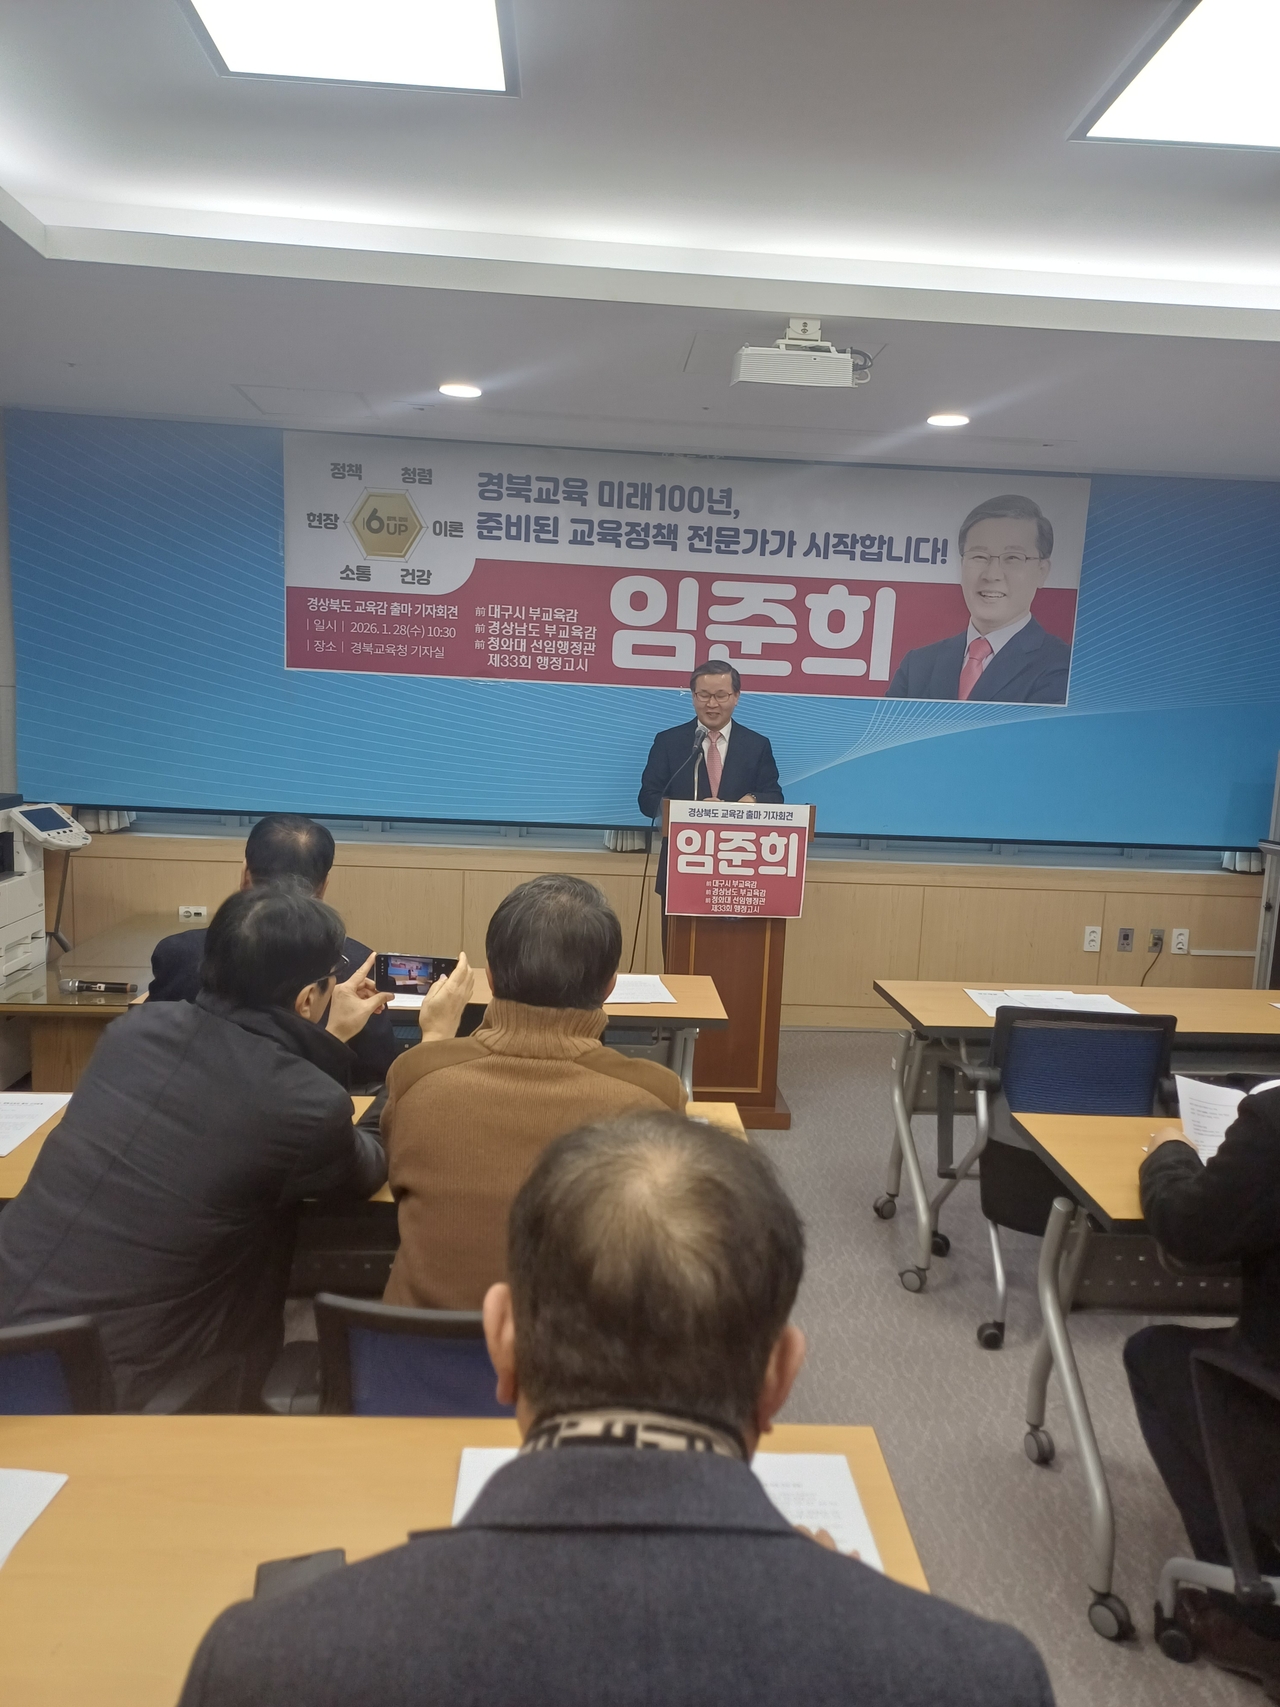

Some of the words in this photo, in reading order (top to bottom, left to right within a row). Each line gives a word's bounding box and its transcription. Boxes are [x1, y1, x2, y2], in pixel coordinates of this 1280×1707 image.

[330, 463, 363, 481] 정책
[401, 467, 433, 485] 청렴
[477, 472, 589, 507] 경북교육
[598, 480, 740, 520] 미래100년,
[306, 512, 340, 530] 현장
[386, 522, 409, 536] UP
[432, 520, 464, 538] 이론
[476, 511, 560, 545] 준비된
[568, 517, 678, 552] 교육정책
[687, 525, 797, 558] 전문가가
[802, 532, 949, 565] 시작합니다!
[339, 564, 372, 582] 소통
[400, 568, 433, 586] 건강
[307, 597, 352, 613] 경상북도
[354, 600, 388, 616] 교육감
[389, 602, 412, 617] 출마
[414, 603, 459, 620] 기자회견
[488, 604, 526, 620] 대구시
[528, 606, 579, 623] 부교육감
[313, 618, 337, 633] 일시
[350, 621, 380, 635] 2026.
[381, 623, 391, 636] 1.
[392, 624, 425, 639] 28(수)
[426, 626, 457, 639] 10:30
[488, 620, 541, 637] 경상남도
[544, 624, 598, 640] 부교육감
[609, 575, 897, 681] 임준희
[313, 640, 337, 653] 장소
[350, 641, 408, 658] 경북교육청
[410, 645, 445, 659] 기자실
[487, 636, 527, 653] 청와대
[530, 639, 597, 656] 선임행정관
[487, 653, 532, 669] 제33회
[536, 655, 589, 672] 행정고시
[688, 807, 719, 818] 경상북도
[720, 809, 744, 819] 교육감
[763, 811, 794, 821] 기자회견
[676, 829, 799, 877] 임준희
